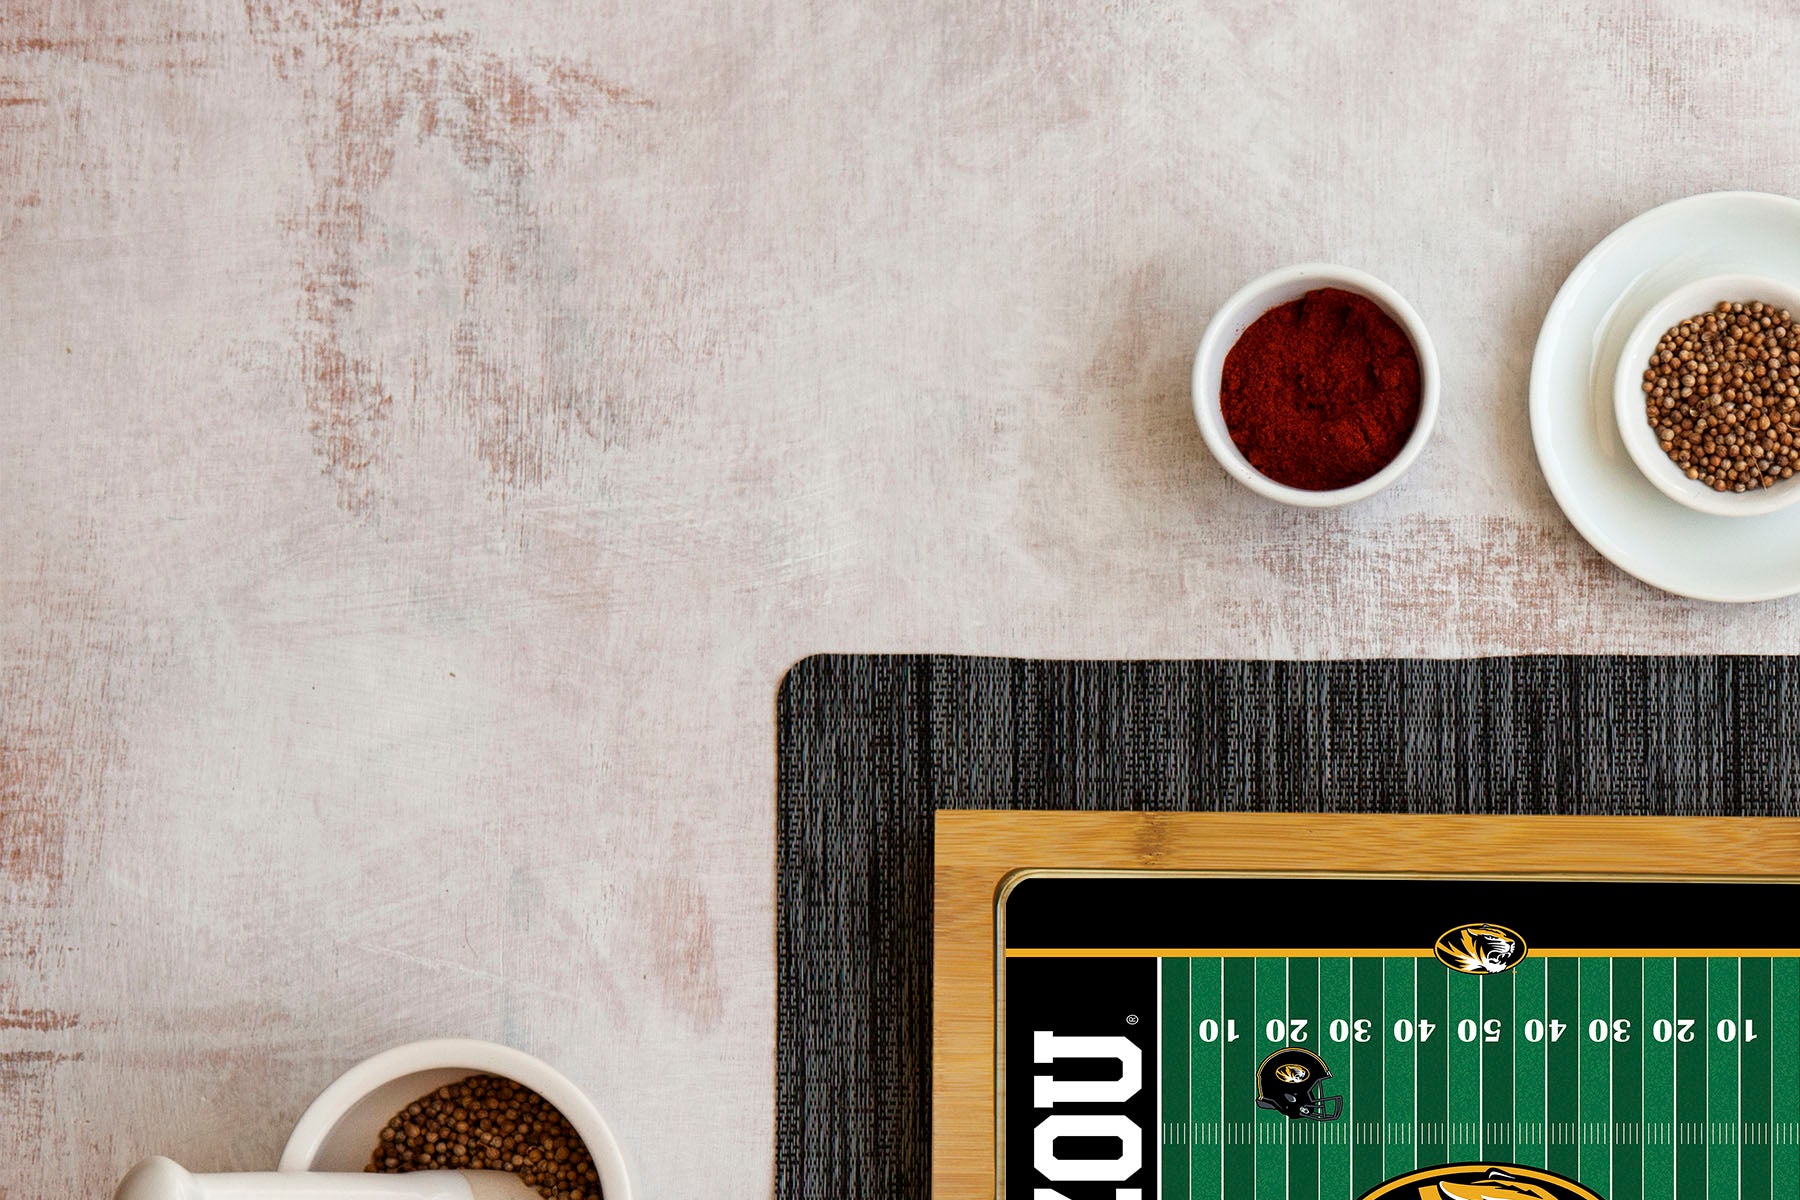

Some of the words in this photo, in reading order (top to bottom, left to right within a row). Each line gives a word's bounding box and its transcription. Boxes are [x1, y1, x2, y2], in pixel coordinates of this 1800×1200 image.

[1199, 1018, 1240, 1043] 10
[1265, 1018, 1308, 1043] 20
[1329, 1018, 1372, 1043] 30
[1393, 1018, 1436, 1043] 40
[1457, 1018, 1502, 1043] 50
[1524, 1018, 1567, 1043] 40
[1588, 1018, 1631, 1043] 30
[1652, 1018, 1695, 1043] 20
[1716, 1018, 1758, 1043] 10
